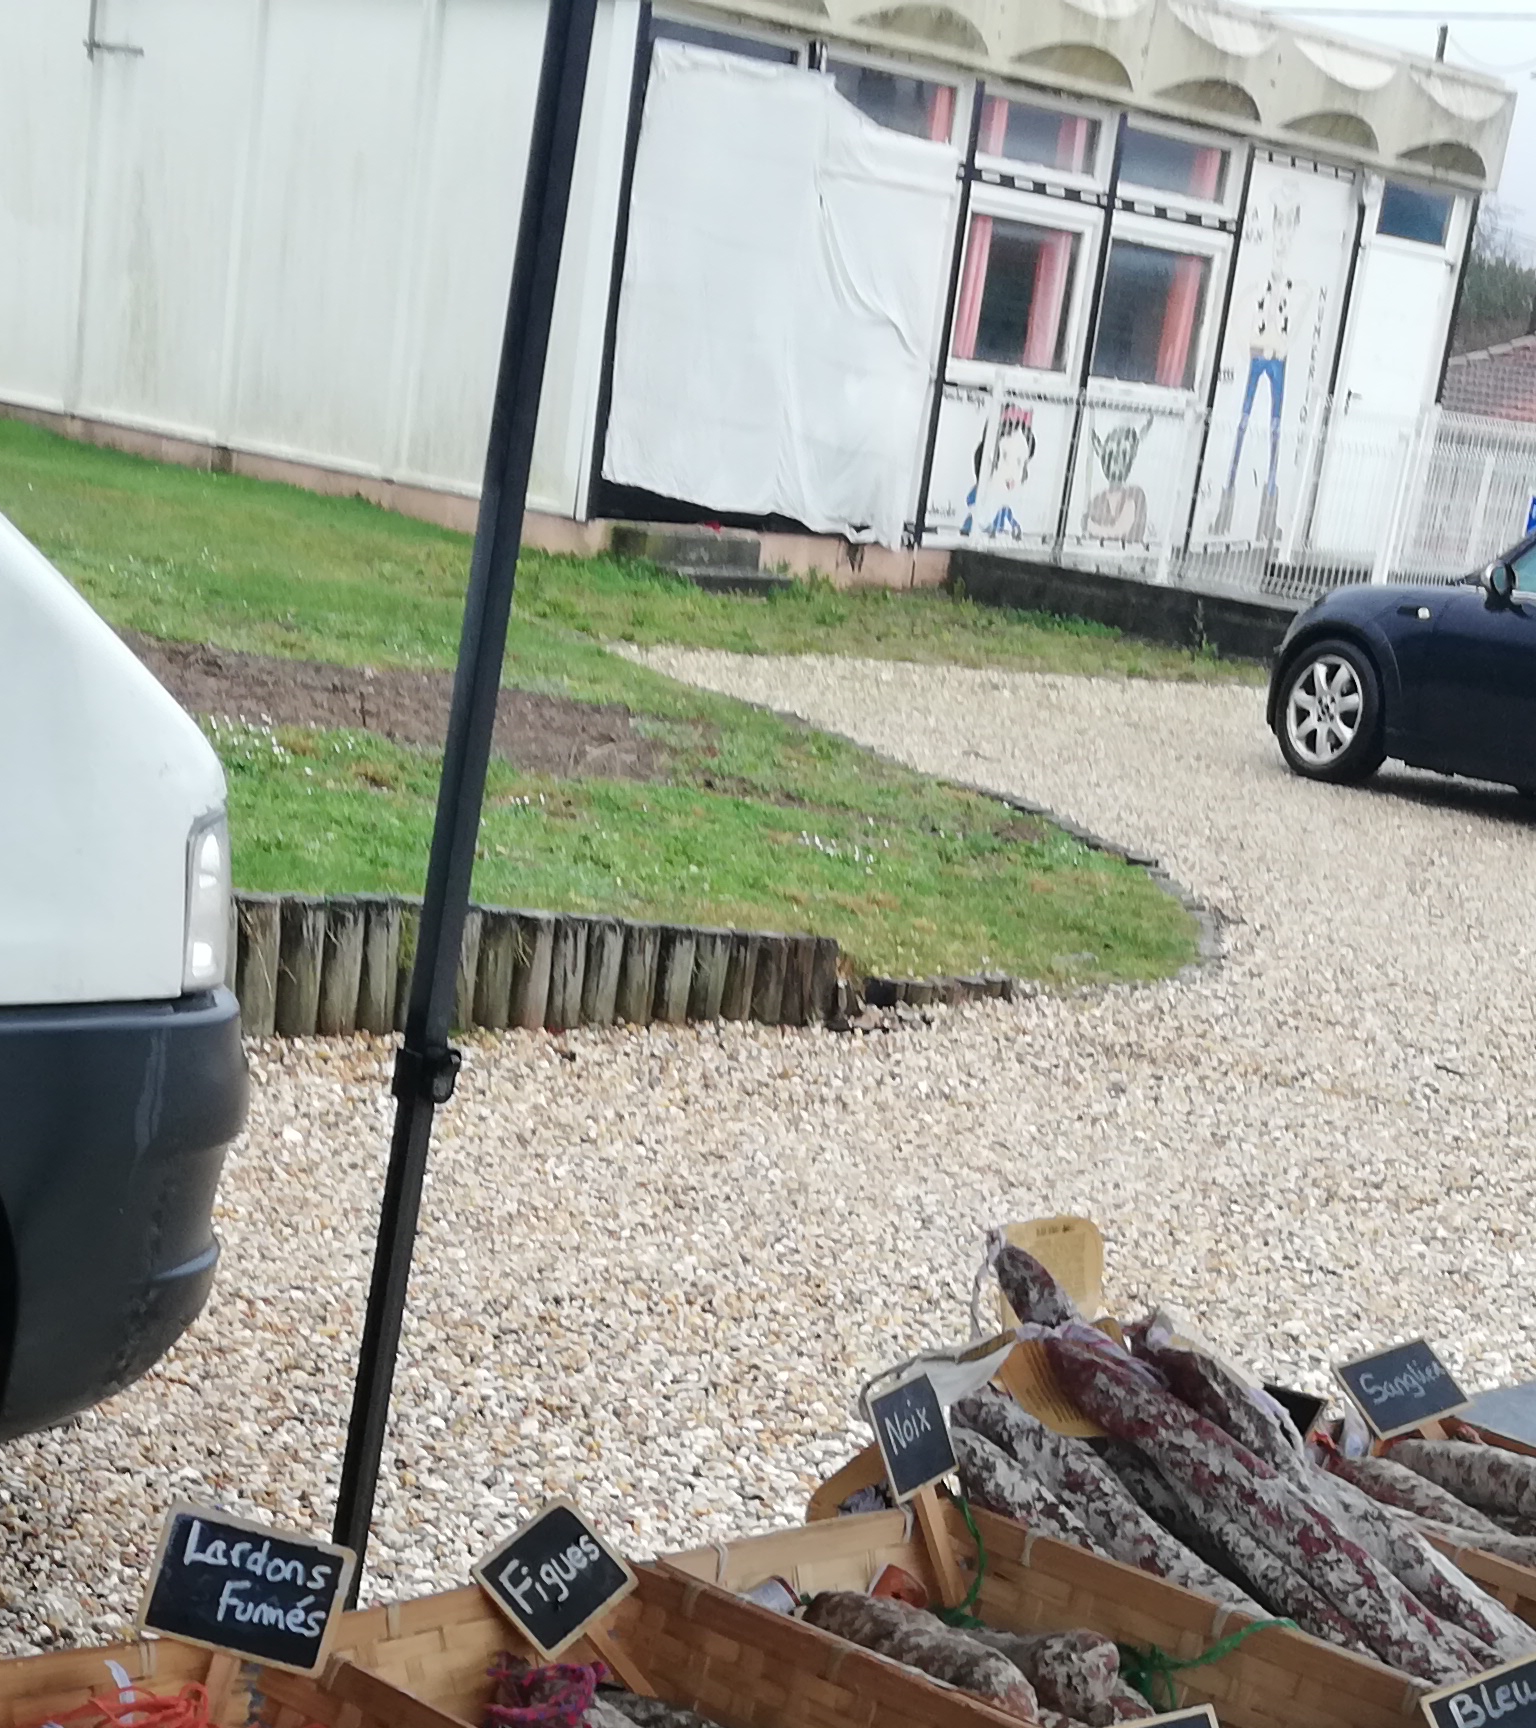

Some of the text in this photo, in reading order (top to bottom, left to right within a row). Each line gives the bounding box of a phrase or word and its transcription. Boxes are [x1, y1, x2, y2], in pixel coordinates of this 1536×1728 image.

[885, 1399, 932, 1456] Noix
[183, 1519, 332, 1590] Lardons
[498, 1534, 600, 1614] Figues
[217, 1579, 326, 1638] Fumés
